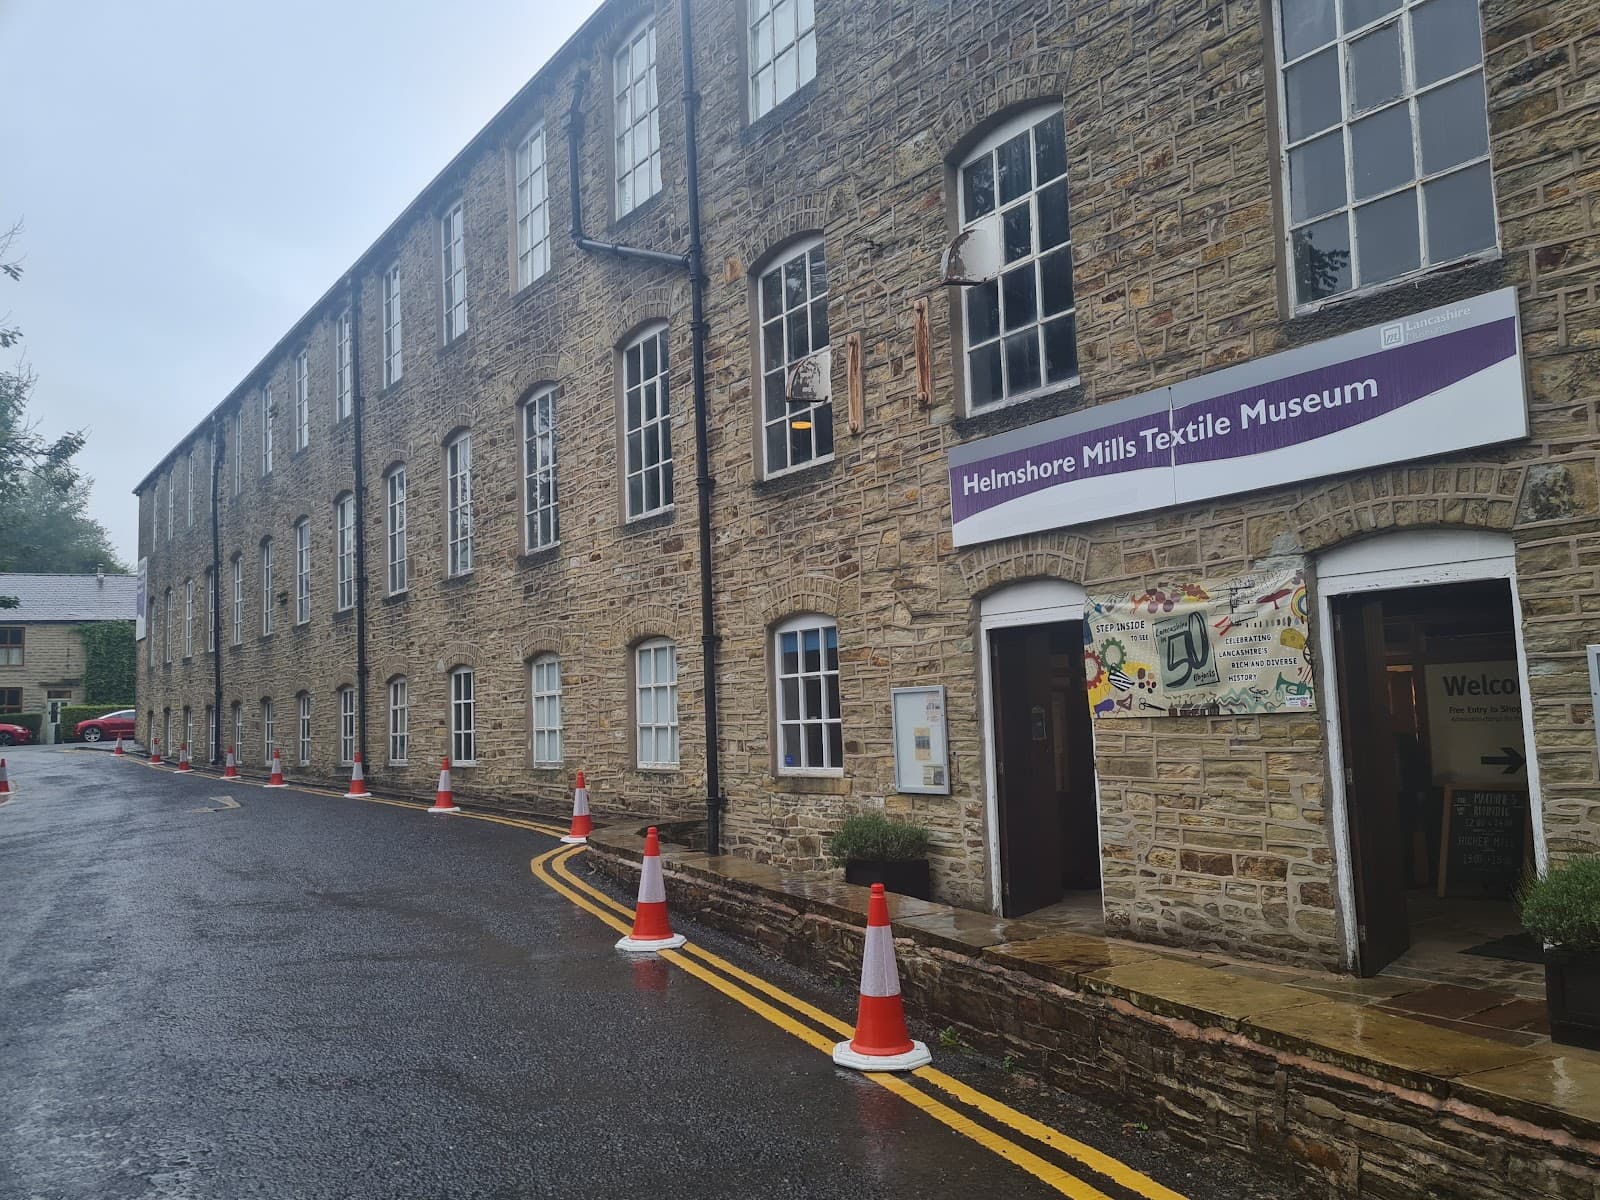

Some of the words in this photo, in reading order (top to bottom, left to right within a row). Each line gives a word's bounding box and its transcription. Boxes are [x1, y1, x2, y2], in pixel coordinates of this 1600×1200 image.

[1405, 306, 1472, 331] Lancashire
[963, 456, 1076, 496] Helmshore
[1082, 434, 1137, 468] Mills
[1139, 412, 1231, 453] Textile
[1240, 377, 1378, 430] Museum
[1096, 624, 1114, 633] STEP
[1117, 620, 1145, 631] INSIDE
[1225, 634, 1271, 645] CELEBRATING
[1219, 647, 1268, 658] LANCASHIRE'S
[1231, 661, 1249, 669] RICH
[1266, 657, 1298, 667] DIVERSE
[1228, 674, 1257, 682] HISTORY
[1442, 673, 1519, 696] Welco
